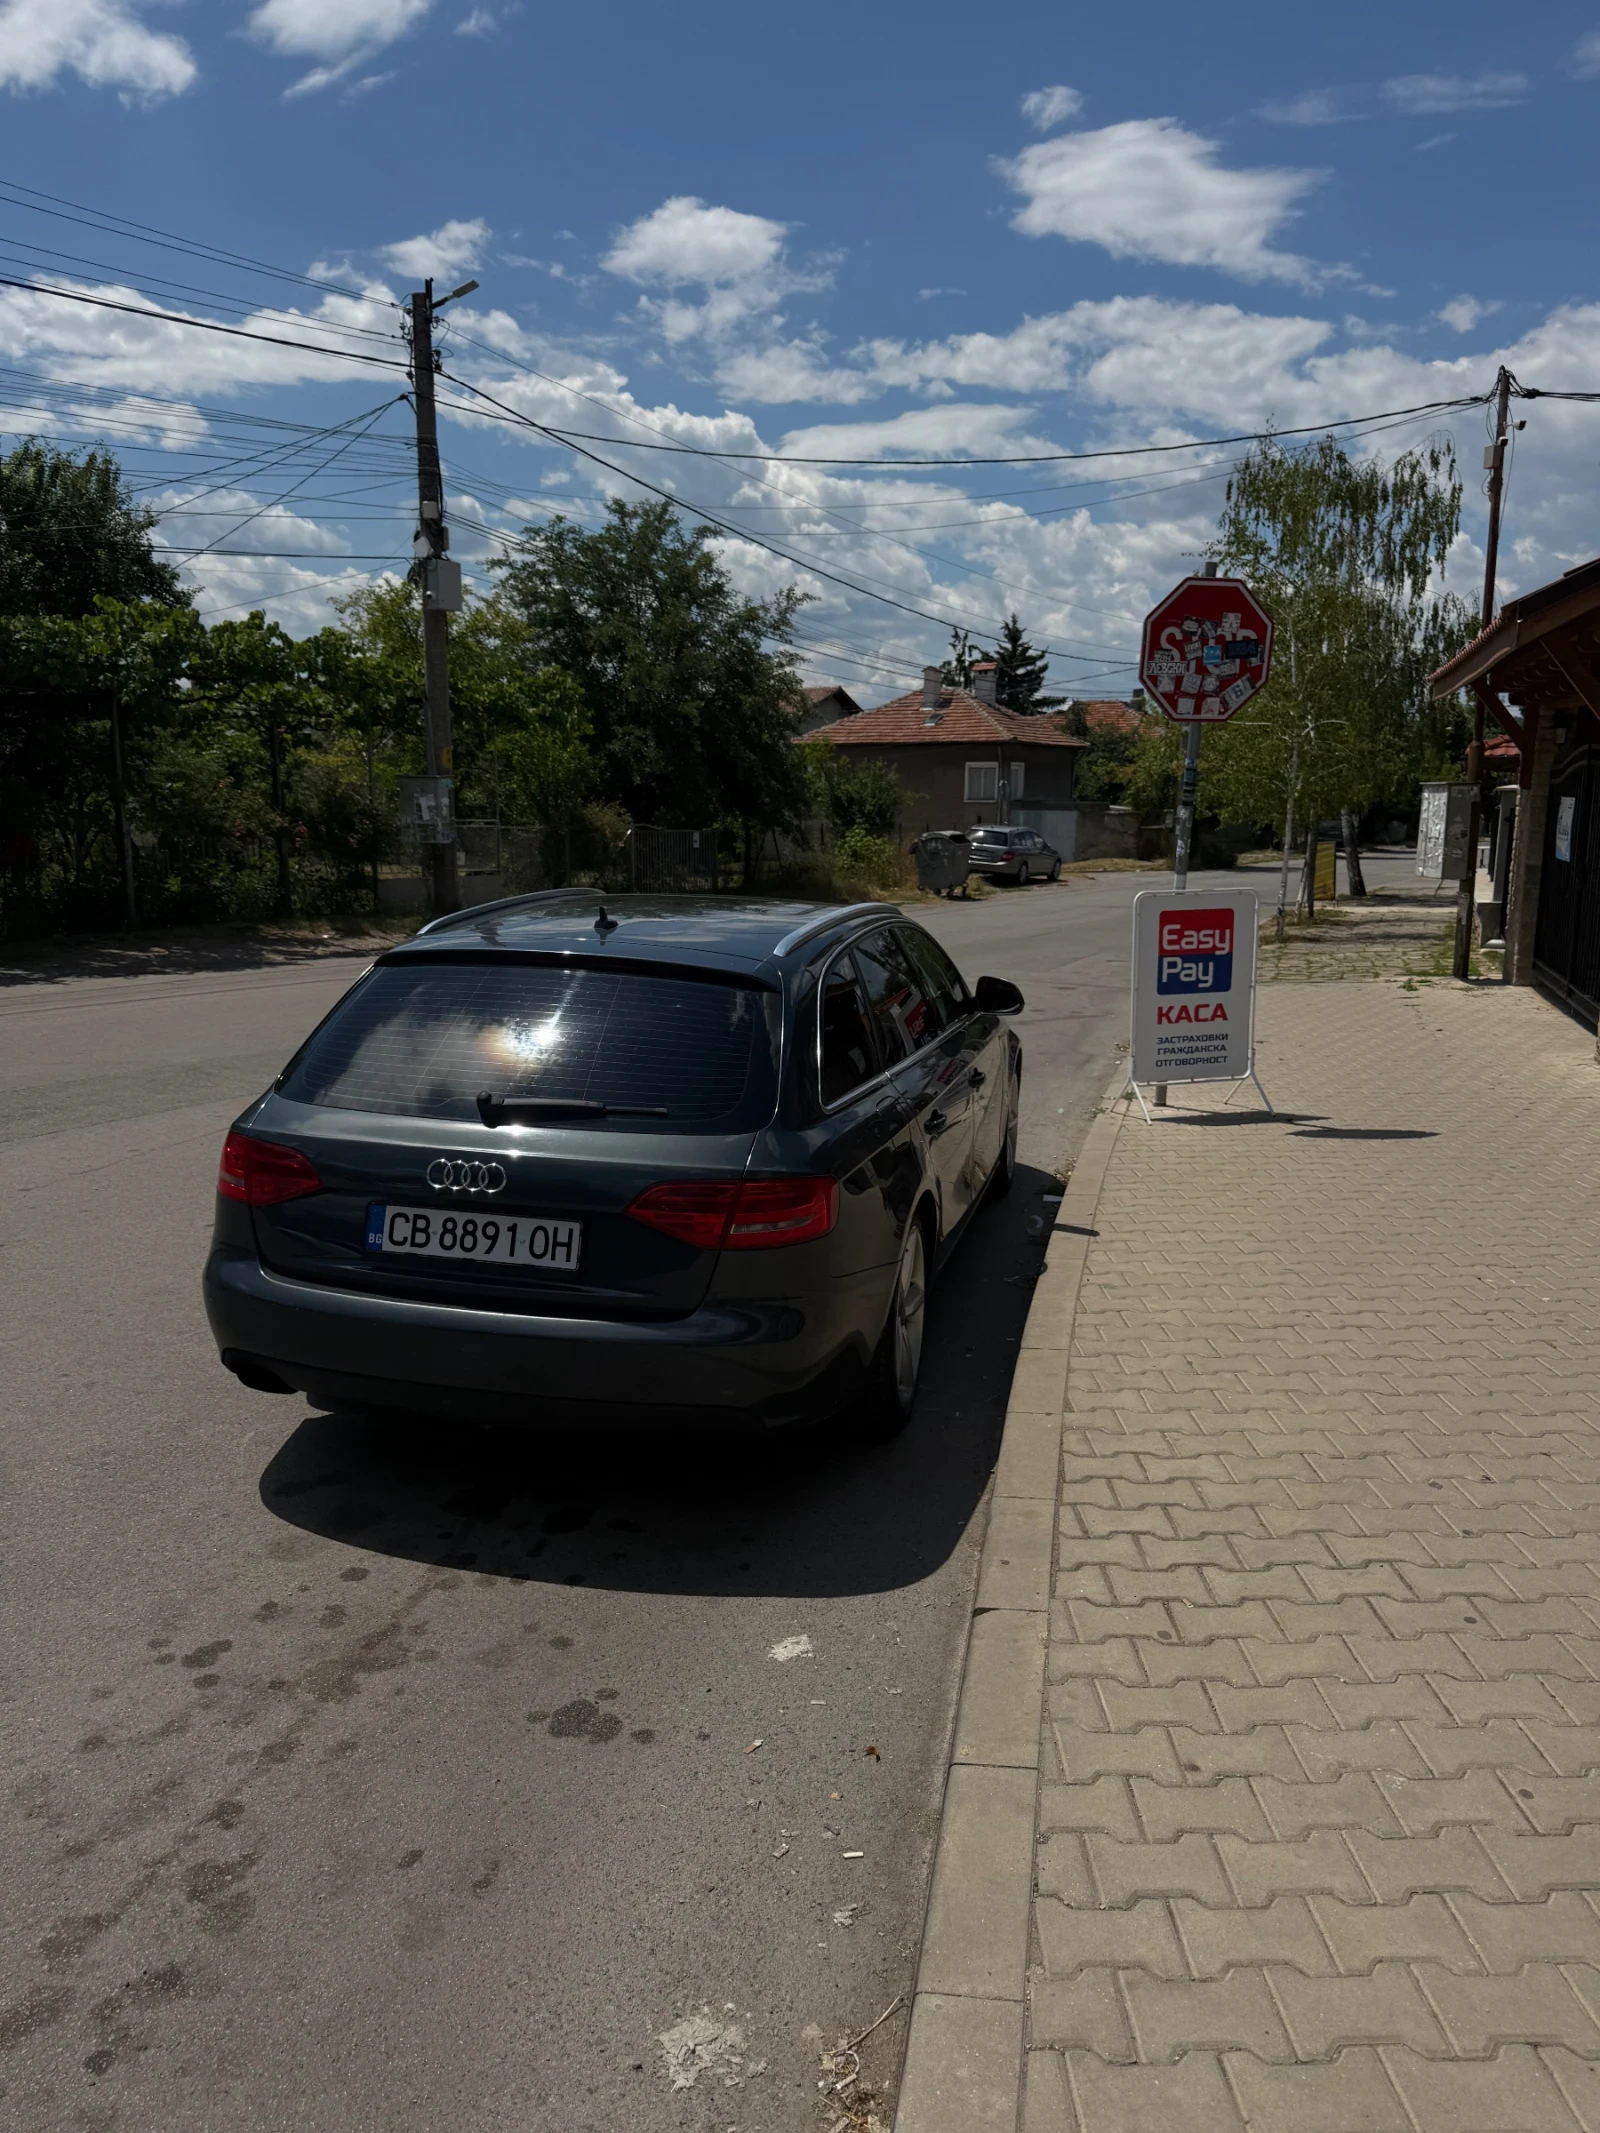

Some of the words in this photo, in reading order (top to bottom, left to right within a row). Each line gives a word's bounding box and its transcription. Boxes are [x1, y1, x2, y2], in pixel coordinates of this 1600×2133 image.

[1162, 924, 1230, 956] Easy
[1161, 957, 1214, 988] Pay
[1157, 1003, 1229, 1025] КАСА
[1156, 1033, 1229, 1045] ЗАСТРАХОВКИ
[1157, 1044, 1227, 1056] ГРАЖДАНСКА
[1155, 1056, 1229, 1068] ОТГОВОРНОСТ
[368, 1233, 383, 1244] BG
[439, 1217, 518, 1258] 8891
